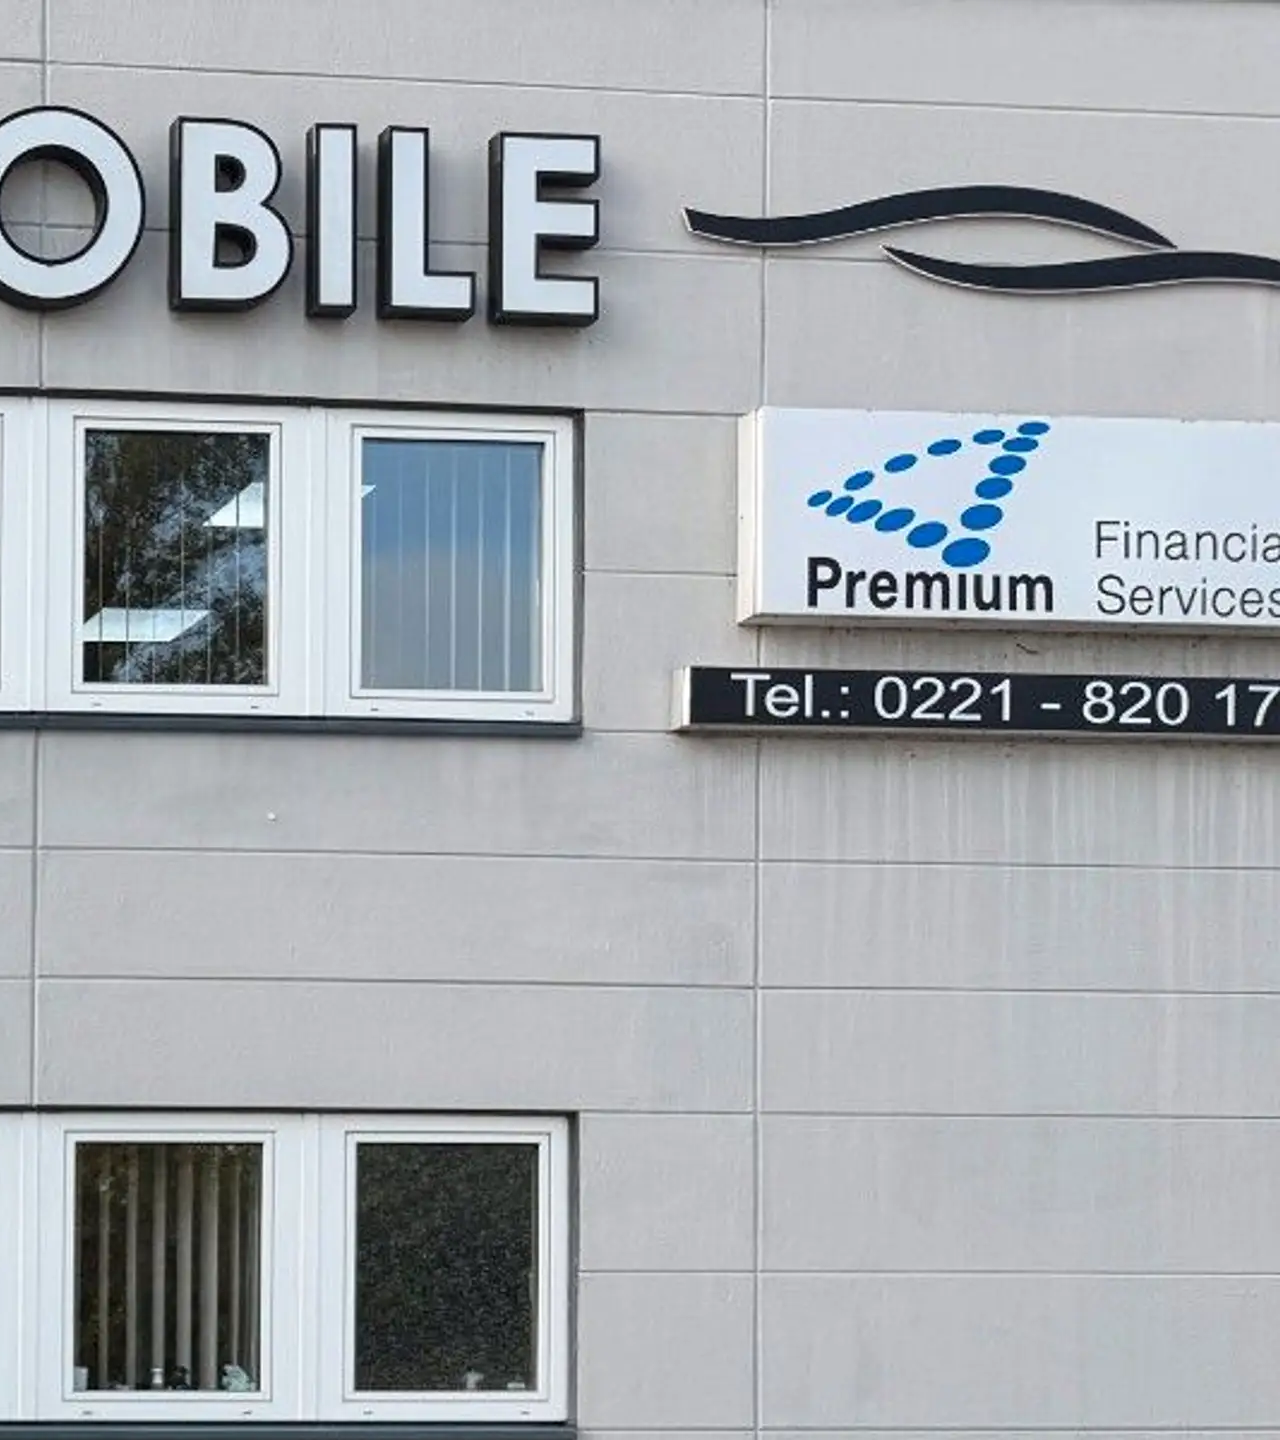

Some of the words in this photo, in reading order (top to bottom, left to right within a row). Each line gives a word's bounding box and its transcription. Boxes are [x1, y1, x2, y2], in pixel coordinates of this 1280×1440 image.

[806, 556, 1054, 612] Premium
[730, 671, 850, 719] Tel.:
[874, 675, 1012, 722] 0221
[1081, 680, 1191, 726] 820
